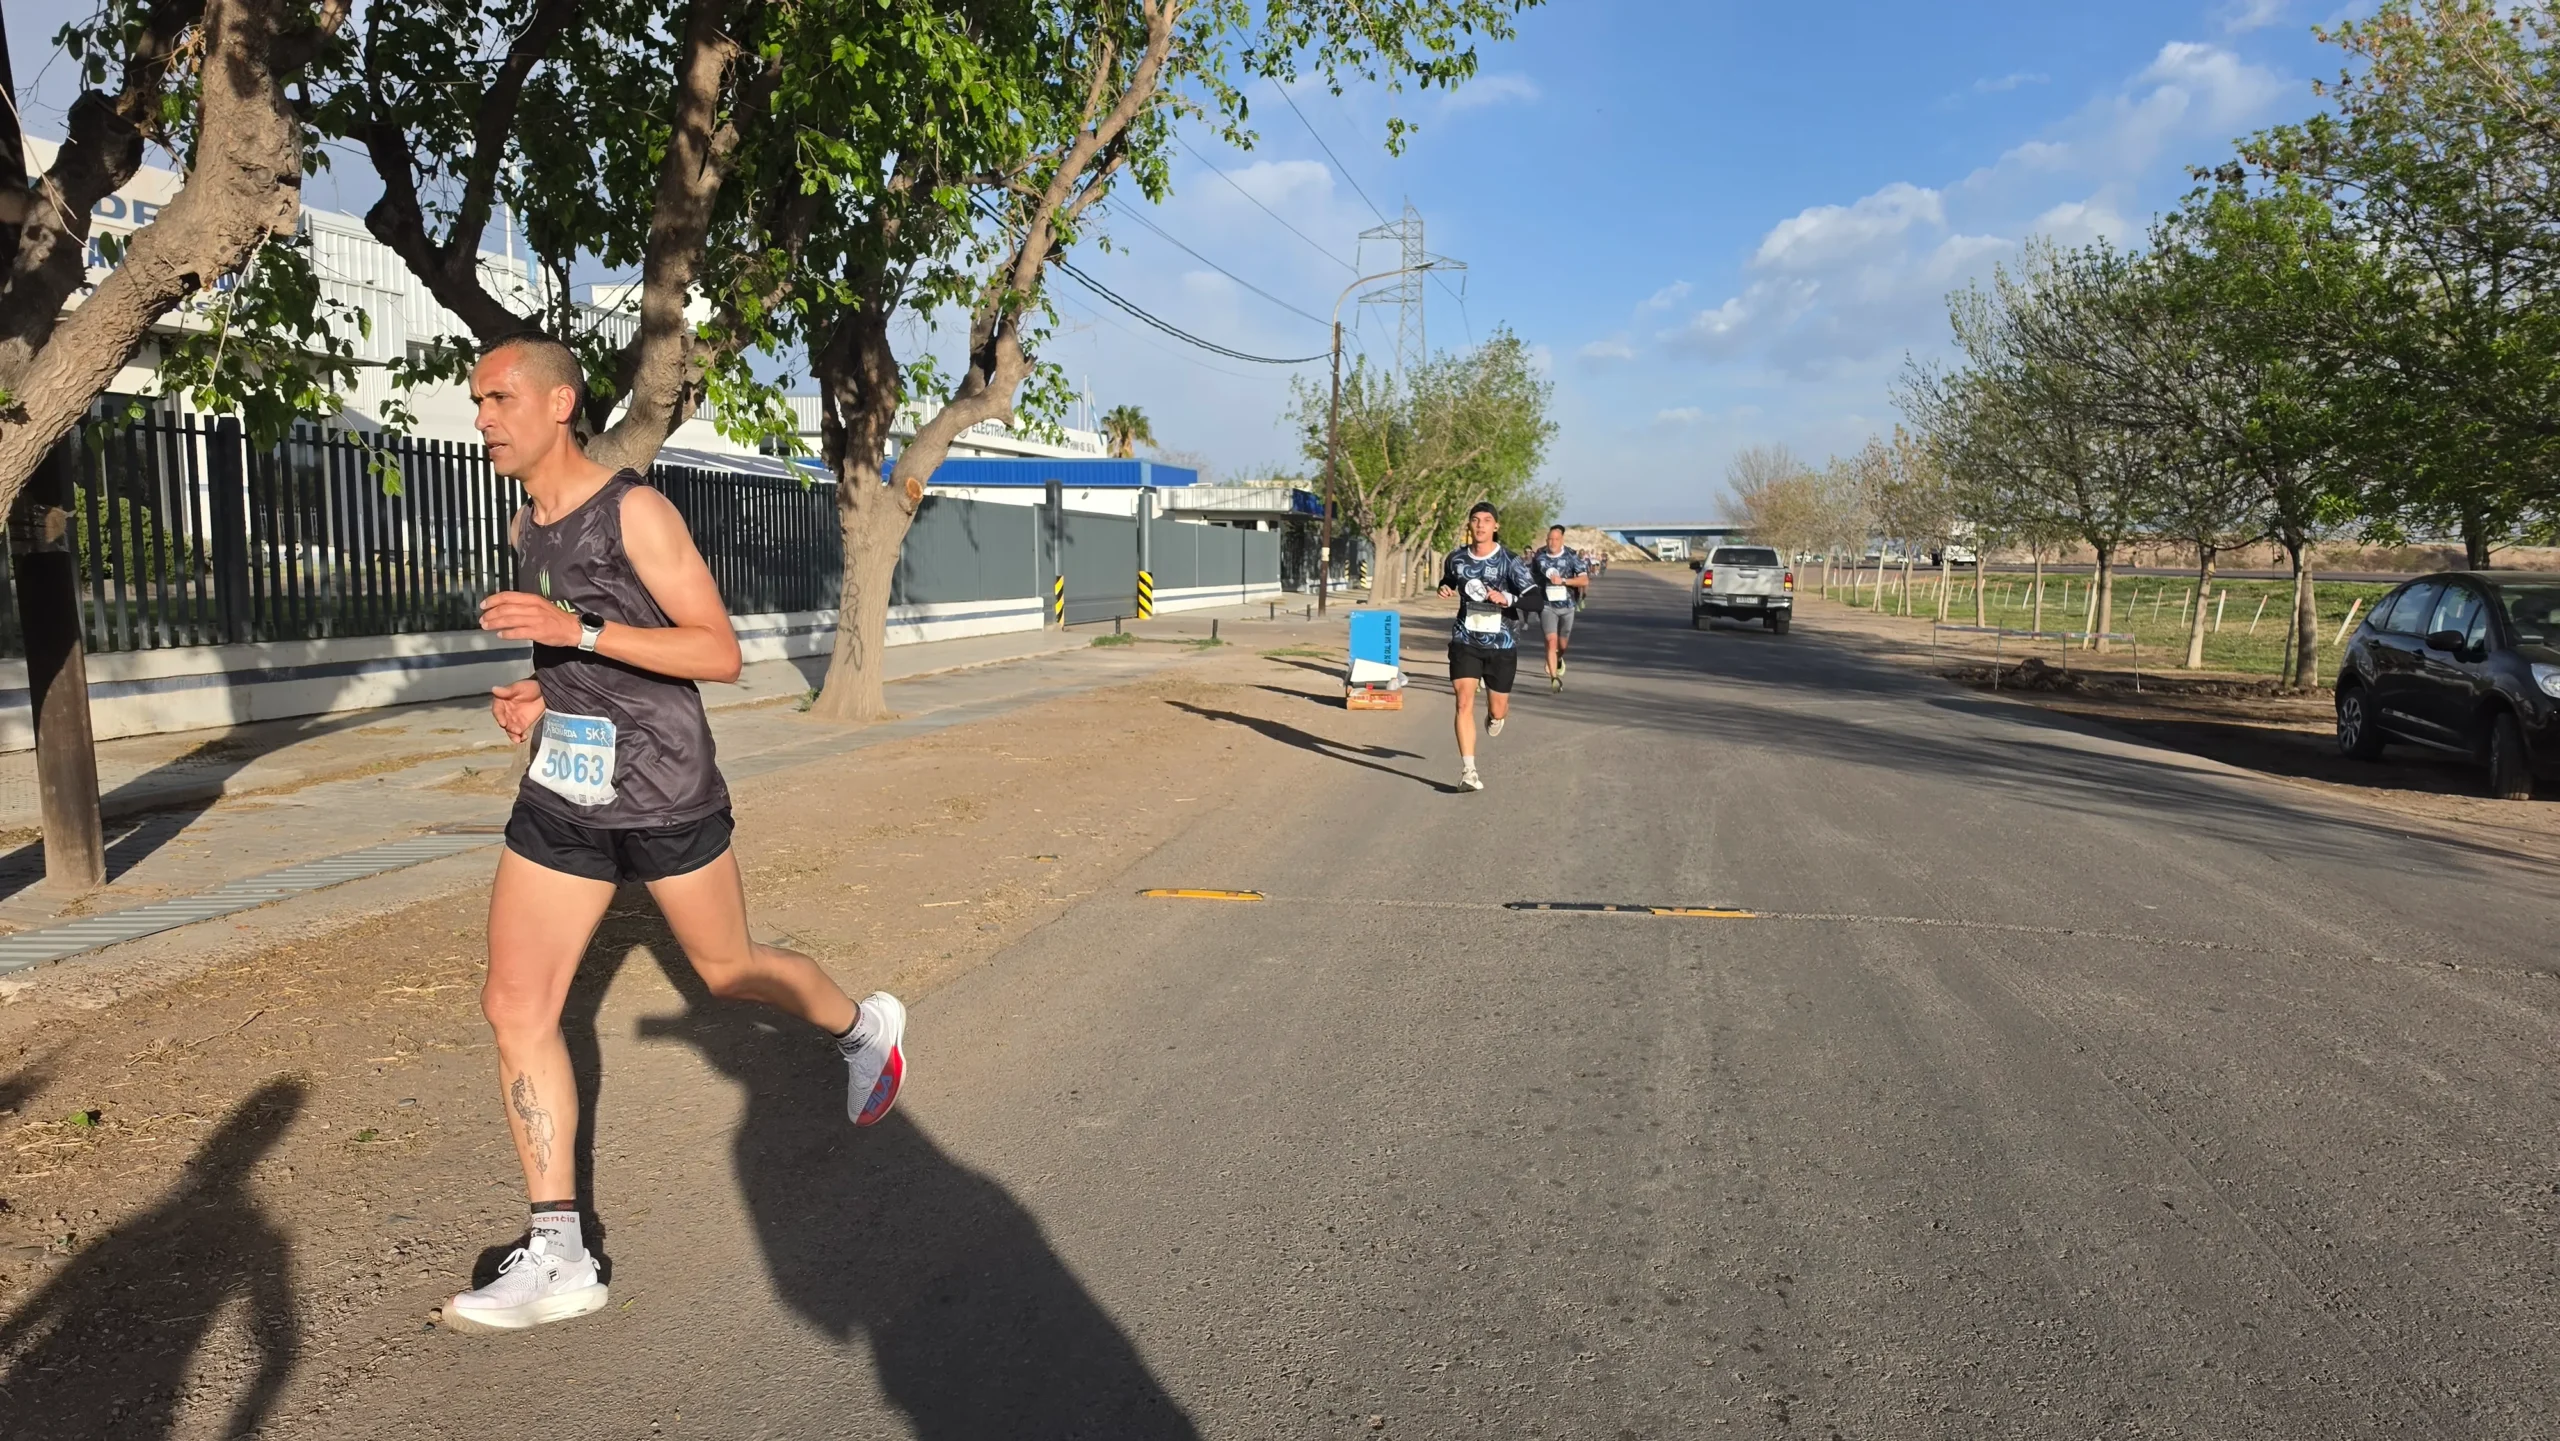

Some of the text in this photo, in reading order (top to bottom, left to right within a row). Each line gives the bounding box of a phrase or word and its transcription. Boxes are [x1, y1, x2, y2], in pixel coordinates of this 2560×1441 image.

[585, 727, 601, 741] 5K
[541, 748, 604, 786] 5063
[864, 1075, 893, 1116] FILA
